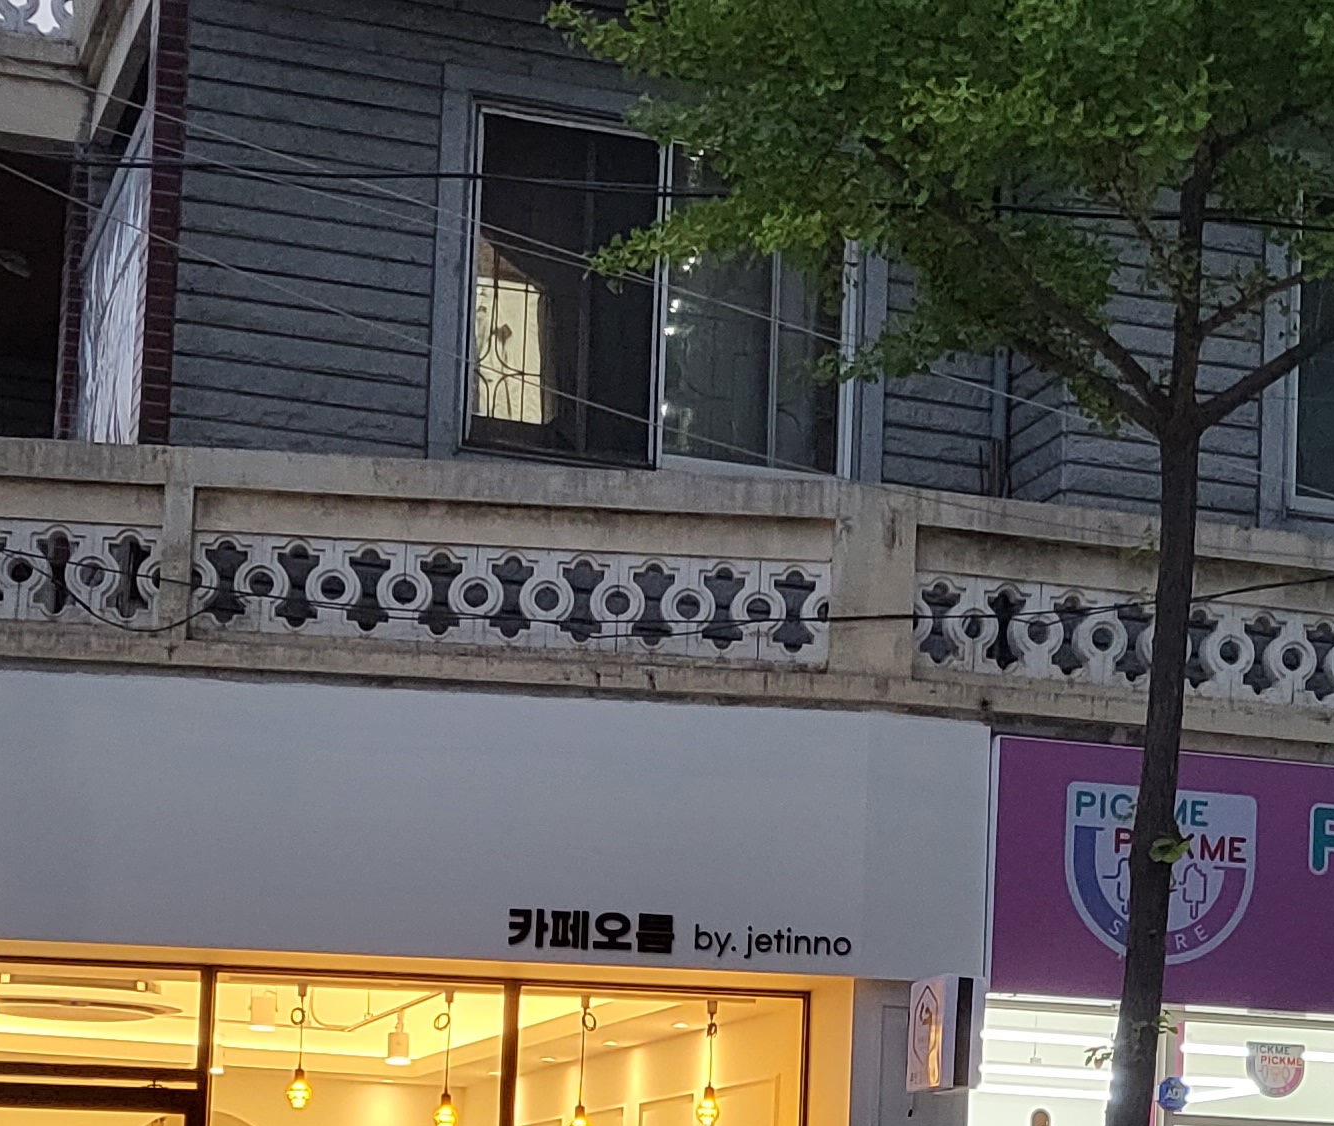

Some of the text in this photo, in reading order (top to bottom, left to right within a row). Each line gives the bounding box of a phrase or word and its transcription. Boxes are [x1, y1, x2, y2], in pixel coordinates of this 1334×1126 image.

[1075, 791, 1209, 827] PICME
[508, 908, 853, 960] 카페오름 by. jetinno
[1109, 919, 1209, 950] SRE
[1260, 1056, 1303, 1067] PICKME
